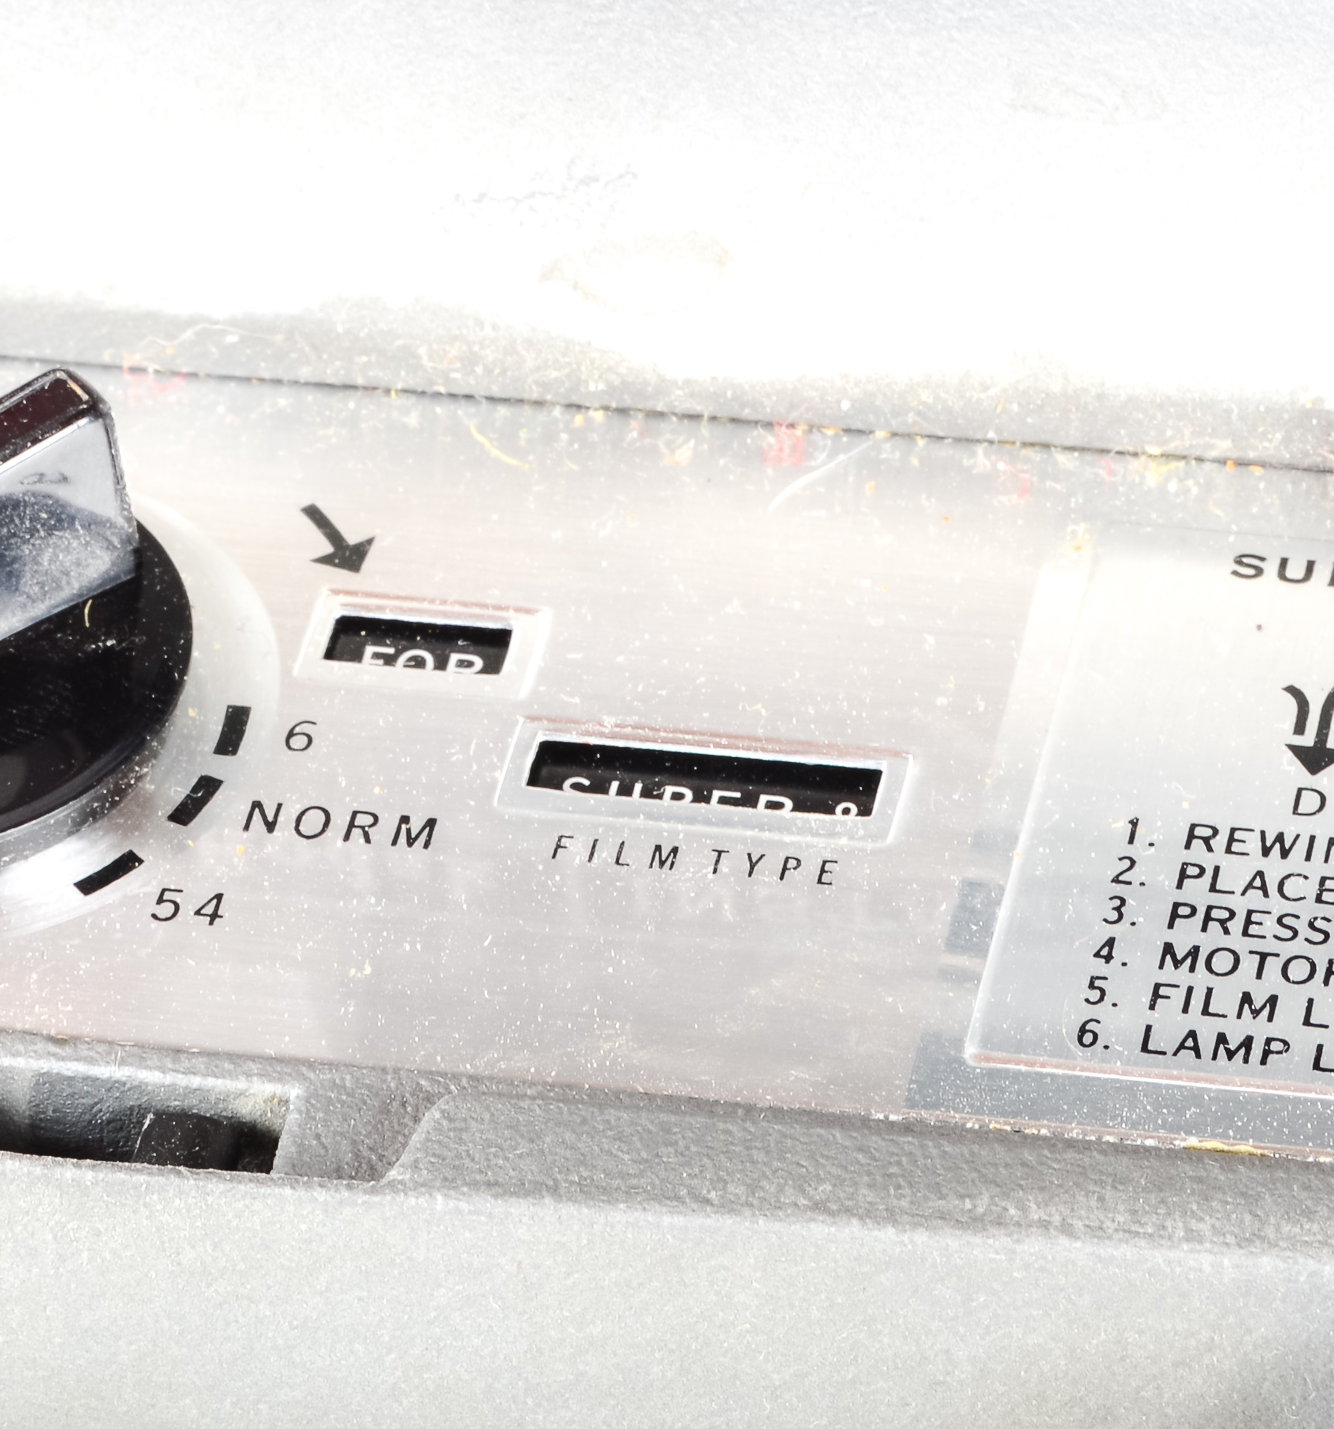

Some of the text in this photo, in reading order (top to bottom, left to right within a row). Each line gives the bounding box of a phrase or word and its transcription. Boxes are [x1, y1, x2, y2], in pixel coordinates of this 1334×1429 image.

[285, 721, 316, 751] 6
[1292, 787, 1326, 816] D
[243, 801, 437, 849] NORM
[1127, 817, 1155, 847] 1.
[552, 835, 838, 885] FILM TYPE
[1110, 856, 1146, 887] 2.
[151, 888, 224, 925] 54
[1103, 895, 1137, 927] 3.
[1167, 902, 1333, 946] PRESS
[1093, 936, 1128, 967] 4.
[1083, 975, 1118, 1008] 5.
[1147, 982, 1278, 1023] FILM
[1076, 1018, 1110, 1051] 6.
[1140, 1024, 1291, 1067] LAMP
